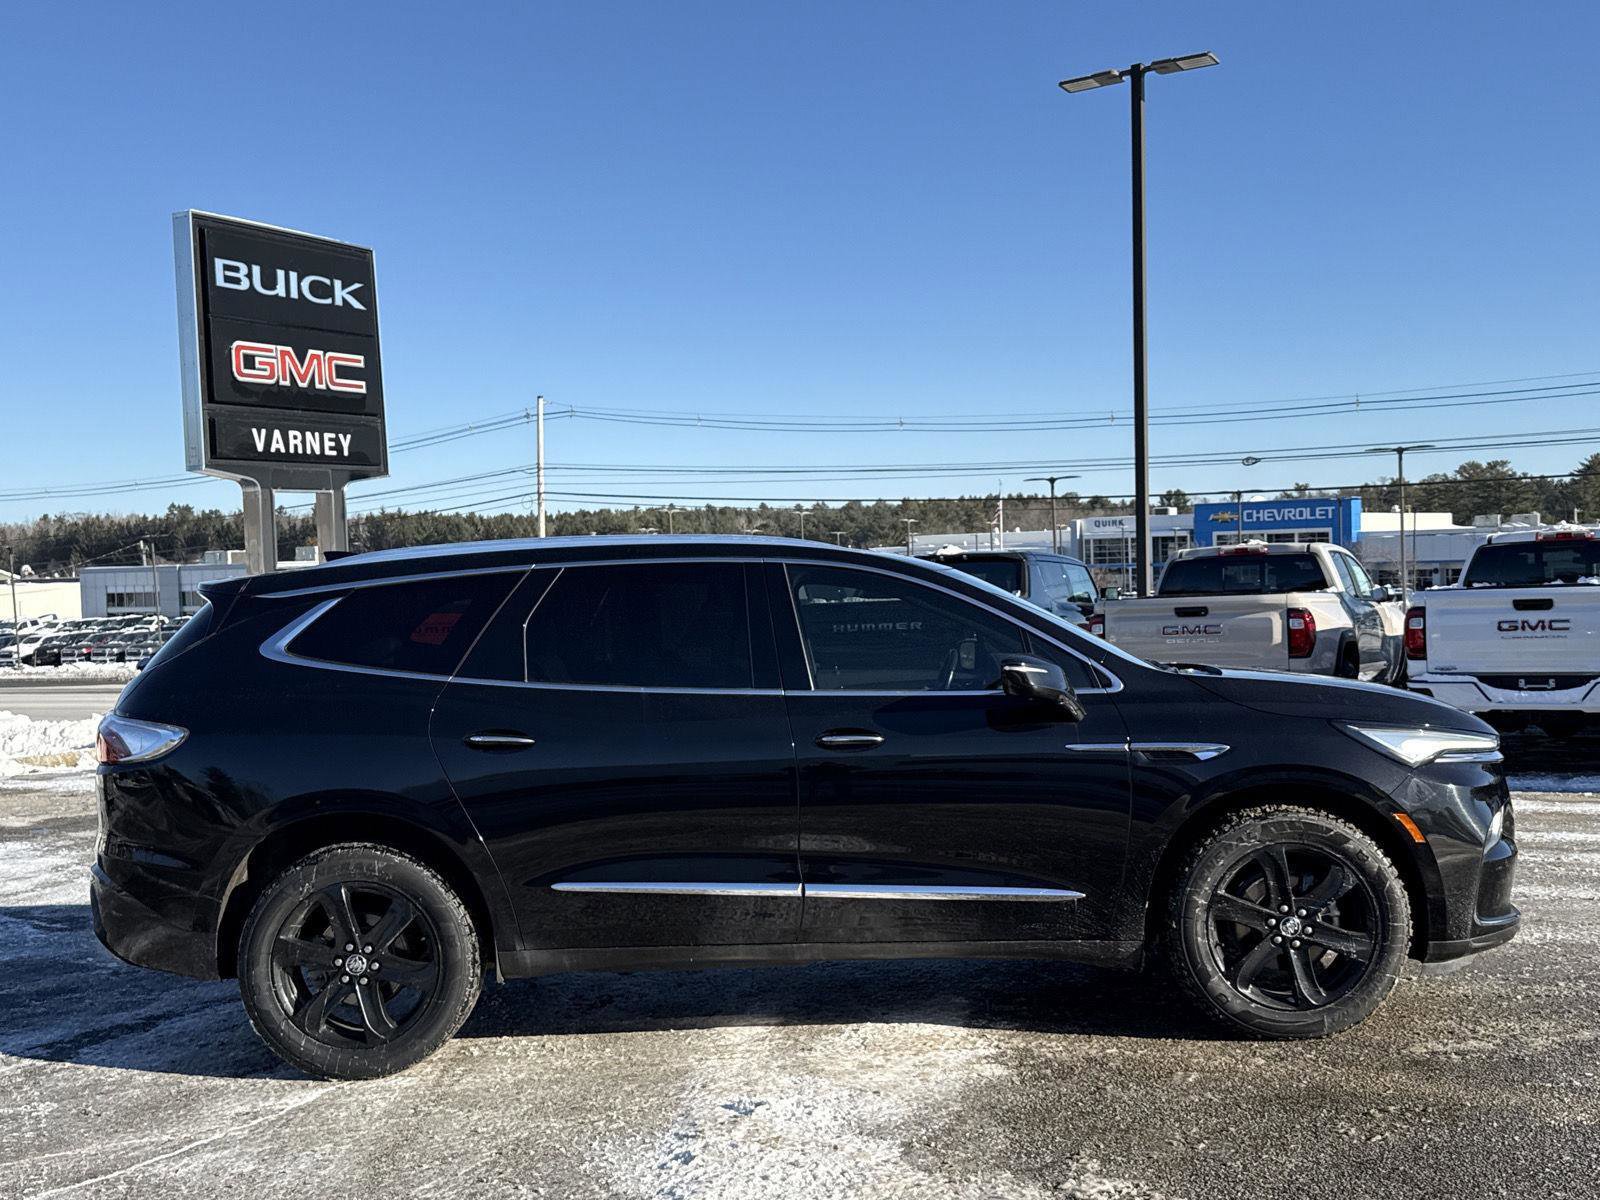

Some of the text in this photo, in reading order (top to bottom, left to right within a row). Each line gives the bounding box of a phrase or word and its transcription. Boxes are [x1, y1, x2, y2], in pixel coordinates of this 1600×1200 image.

[213, 256, 368, 311] BUICK
[230, 340, 368, 394] GMC
[251, 427, 353, 457] VARNEY
[1242, 506, 1336, 522] CHEVROLET
[1094, 519, 1125, 528] QUIRK
[832, 620, 923, 633] HUMMER
[1162, 623, 1224, 637] GMC
[1496, 618, 1571, 632] GMC
